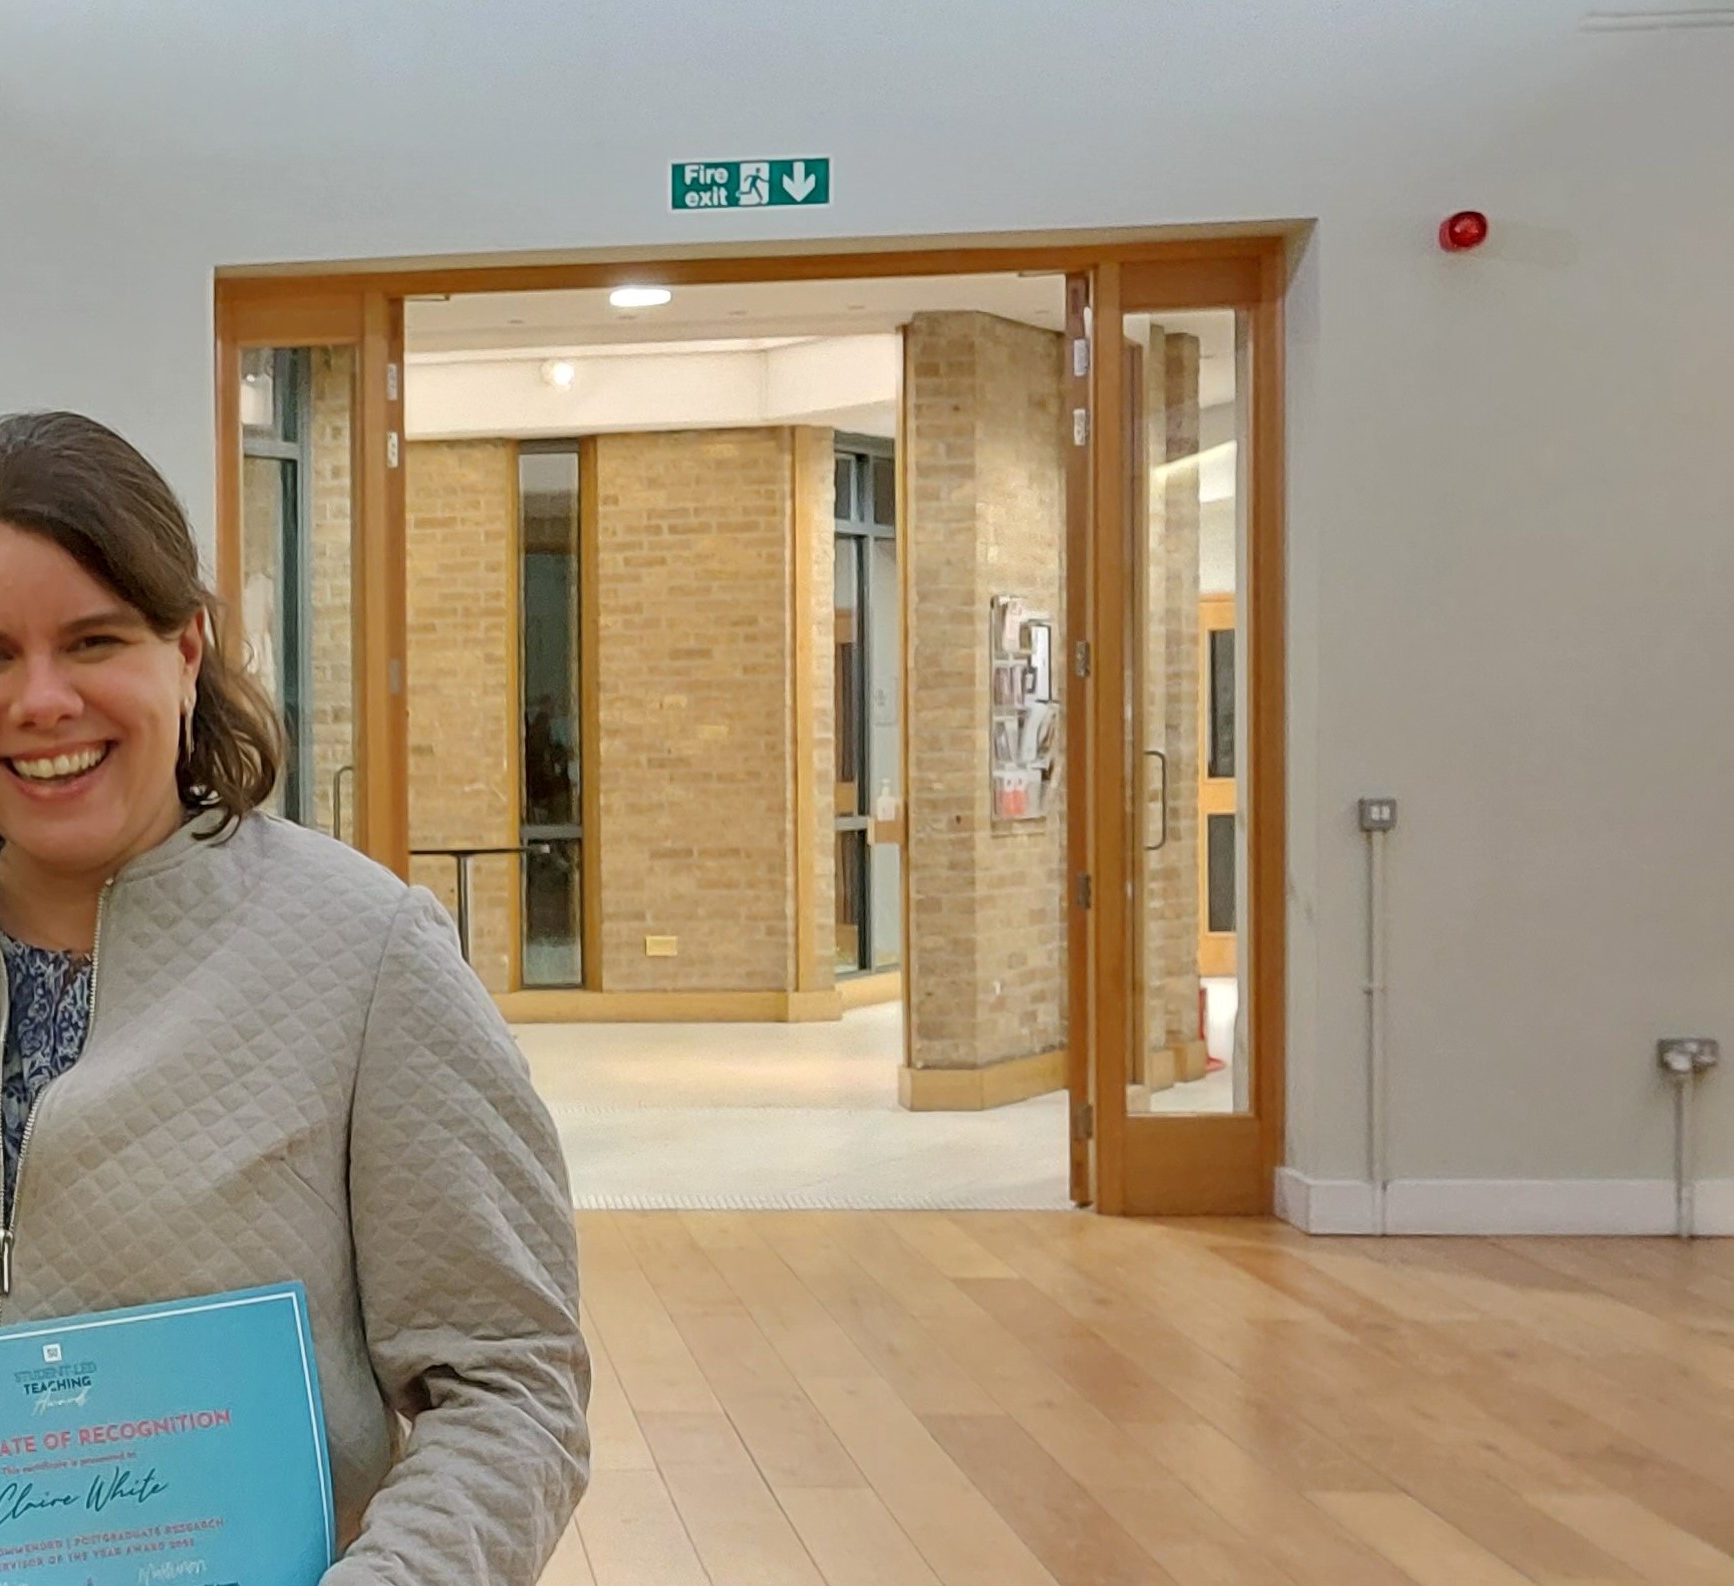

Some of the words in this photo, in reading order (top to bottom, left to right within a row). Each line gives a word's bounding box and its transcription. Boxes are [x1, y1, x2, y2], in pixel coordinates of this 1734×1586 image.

[684, 164, 729, 185] Fire
[684, 186, 728, 207] exit
[23, 1375, 92, 1396] TEACHING
[43, 1431, 71, 1451] OF
[78, 1409, 231, 1445] RECOGNITION
[86, 1467, 169, 1512] White
[74, 1526, 162, 1547] POSTGRADUATE
[166, 1517, 225, 1534] RESEARCH
[49, 1554, 63, 1565] OF
[68, 1551, 88, 1563] THE
[92, 1546, 122, 1559] YEAR
[126, 1541, 165, 1556] AWARD
